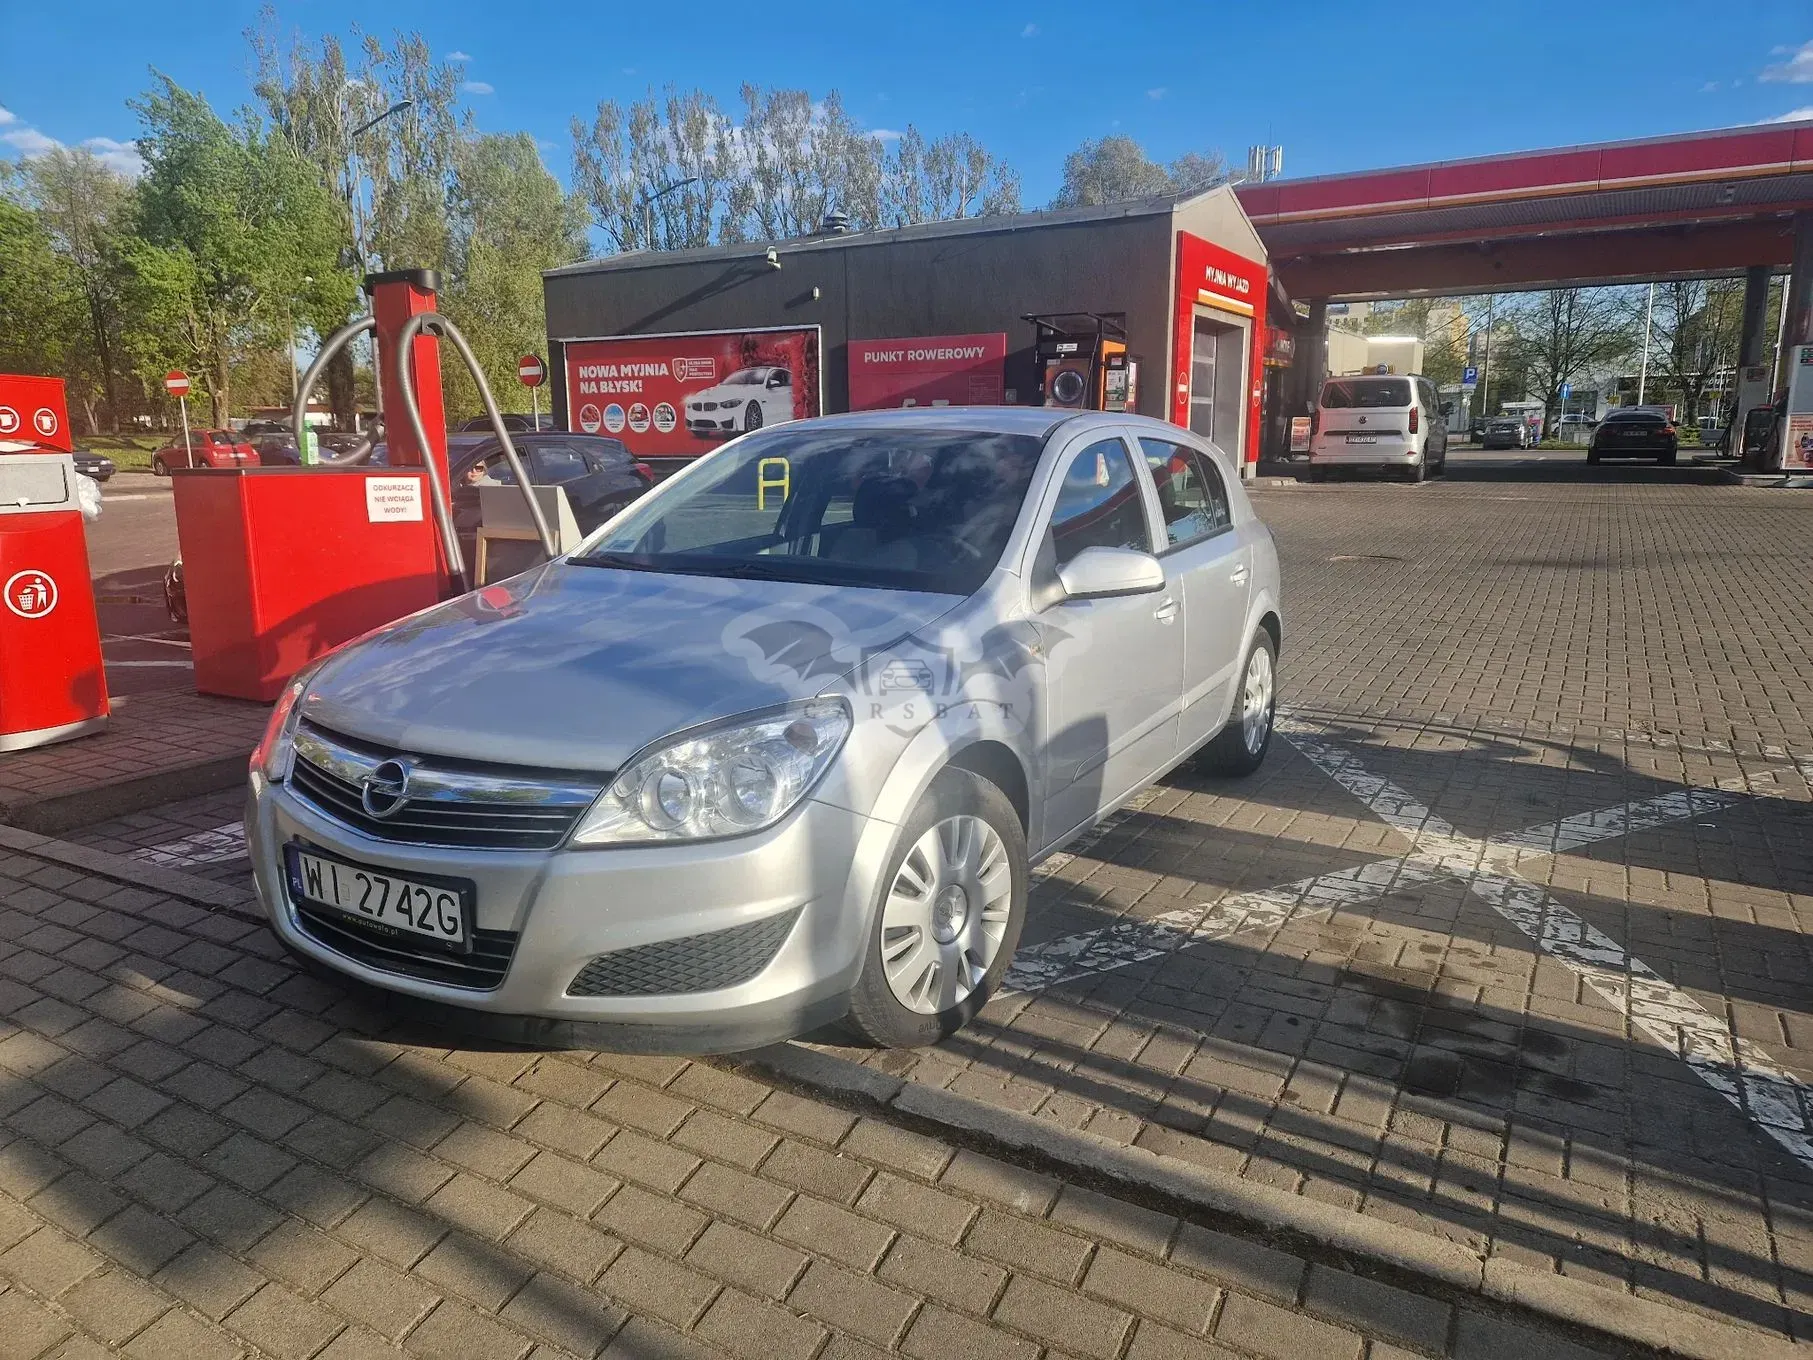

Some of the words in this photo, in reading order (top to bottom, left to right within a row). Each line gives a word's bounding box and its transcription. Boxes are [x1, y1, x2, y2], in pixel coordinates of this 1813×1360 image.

[1205, 265, 1227, 286] MYJNIA
[1227, 273, 1250, 294] WYJAZD
[864, 350, 905, 364] PUNKT
[907, 347, 985, 361] ROWEROWY
[579, 365, 618, 378] NOWA
[620, 363, 669, 377] MYJNIA
[1465, 368, 1476, 380] P
[580, 381, 599, 394] NA
[600, 379, 643, 394] BŁYSK!
[291, 876, 303, 890] PL
[303, 855, 341, 905] WI
[355, 872, 458, 936] 2742G
